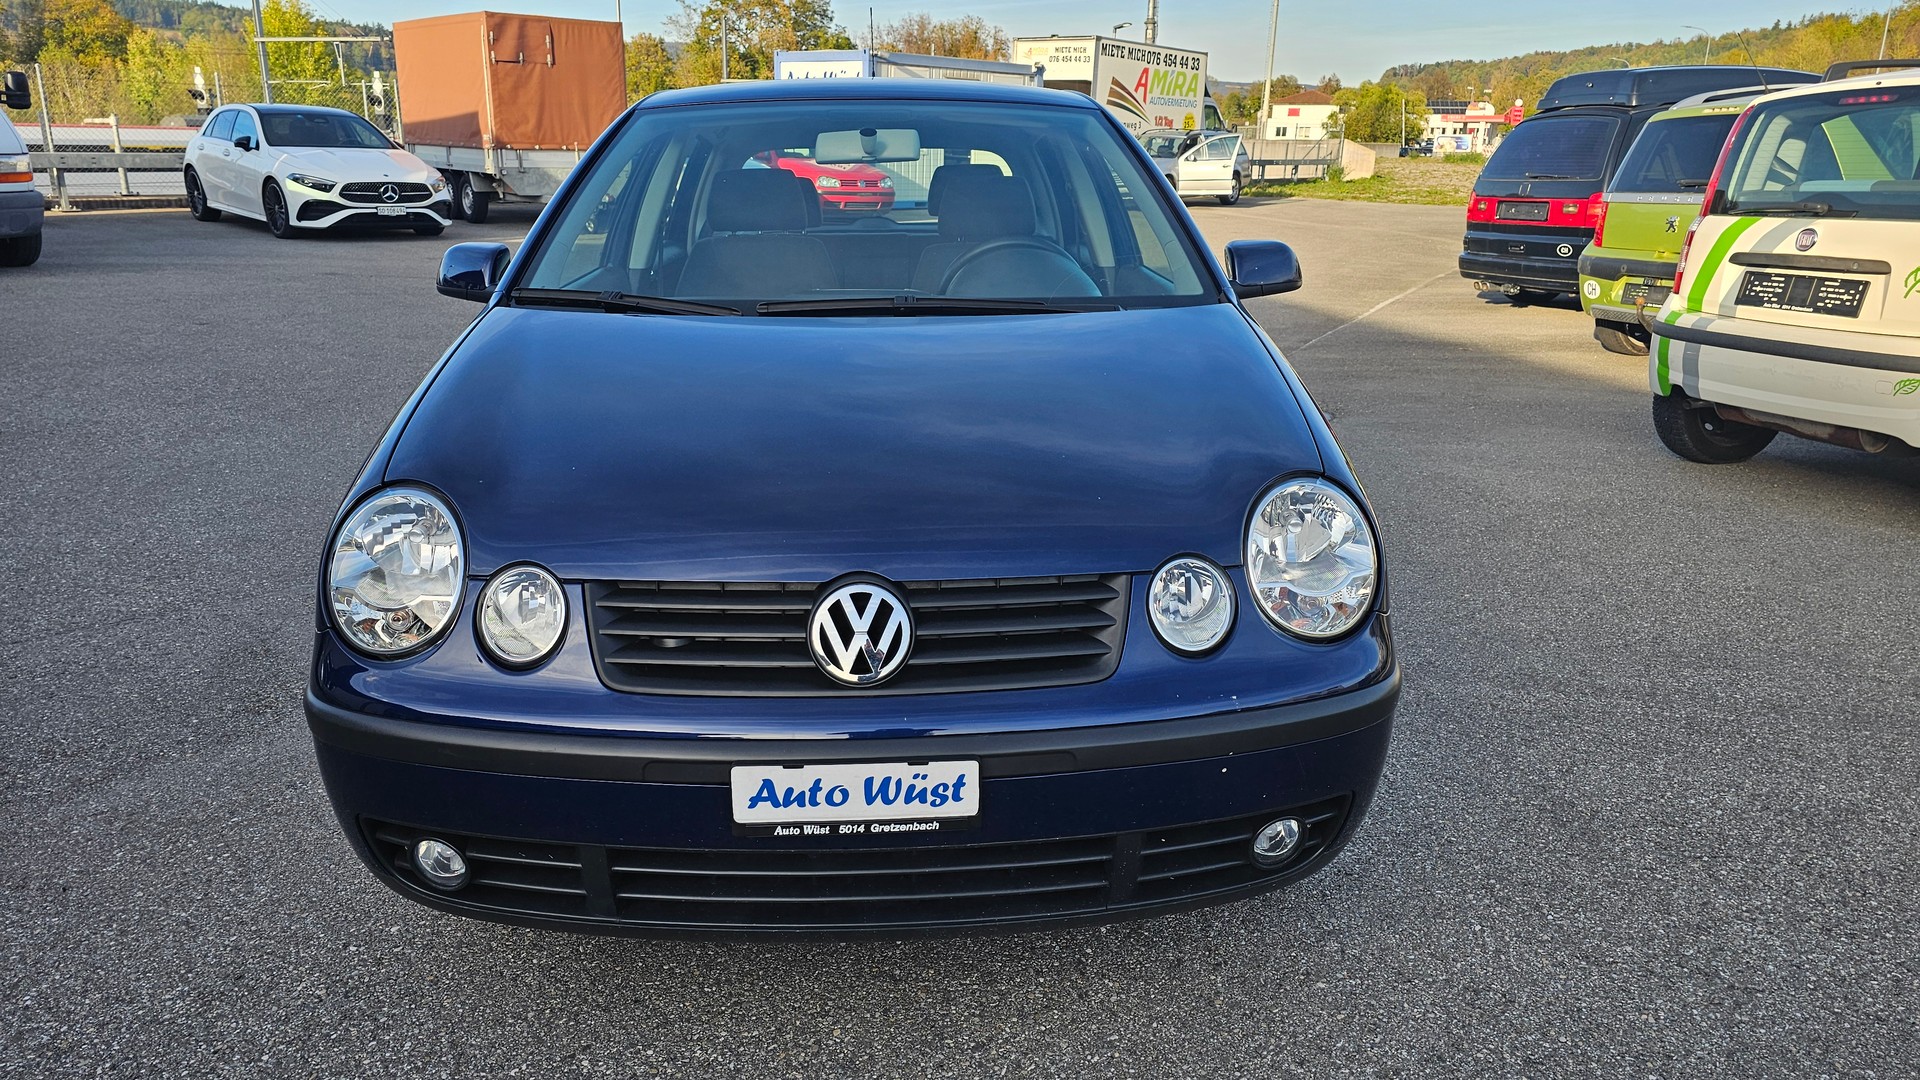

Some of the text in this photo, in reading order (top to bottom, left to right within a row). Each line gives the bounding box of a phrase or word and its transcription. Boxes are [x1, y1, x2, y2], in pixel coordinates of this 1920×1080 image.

[1101, 43, 1201, 71] MIETE MICH 076 454 44 33
[1149, 97, 1198, 109] AUTOVERMIETUNG
[1587, 282, 1597, 297] CH
[747, 772, 967, 810] Auto Wüst
[774, 820, 940, 837] Auto Wüst 5014 Gretzenbach
